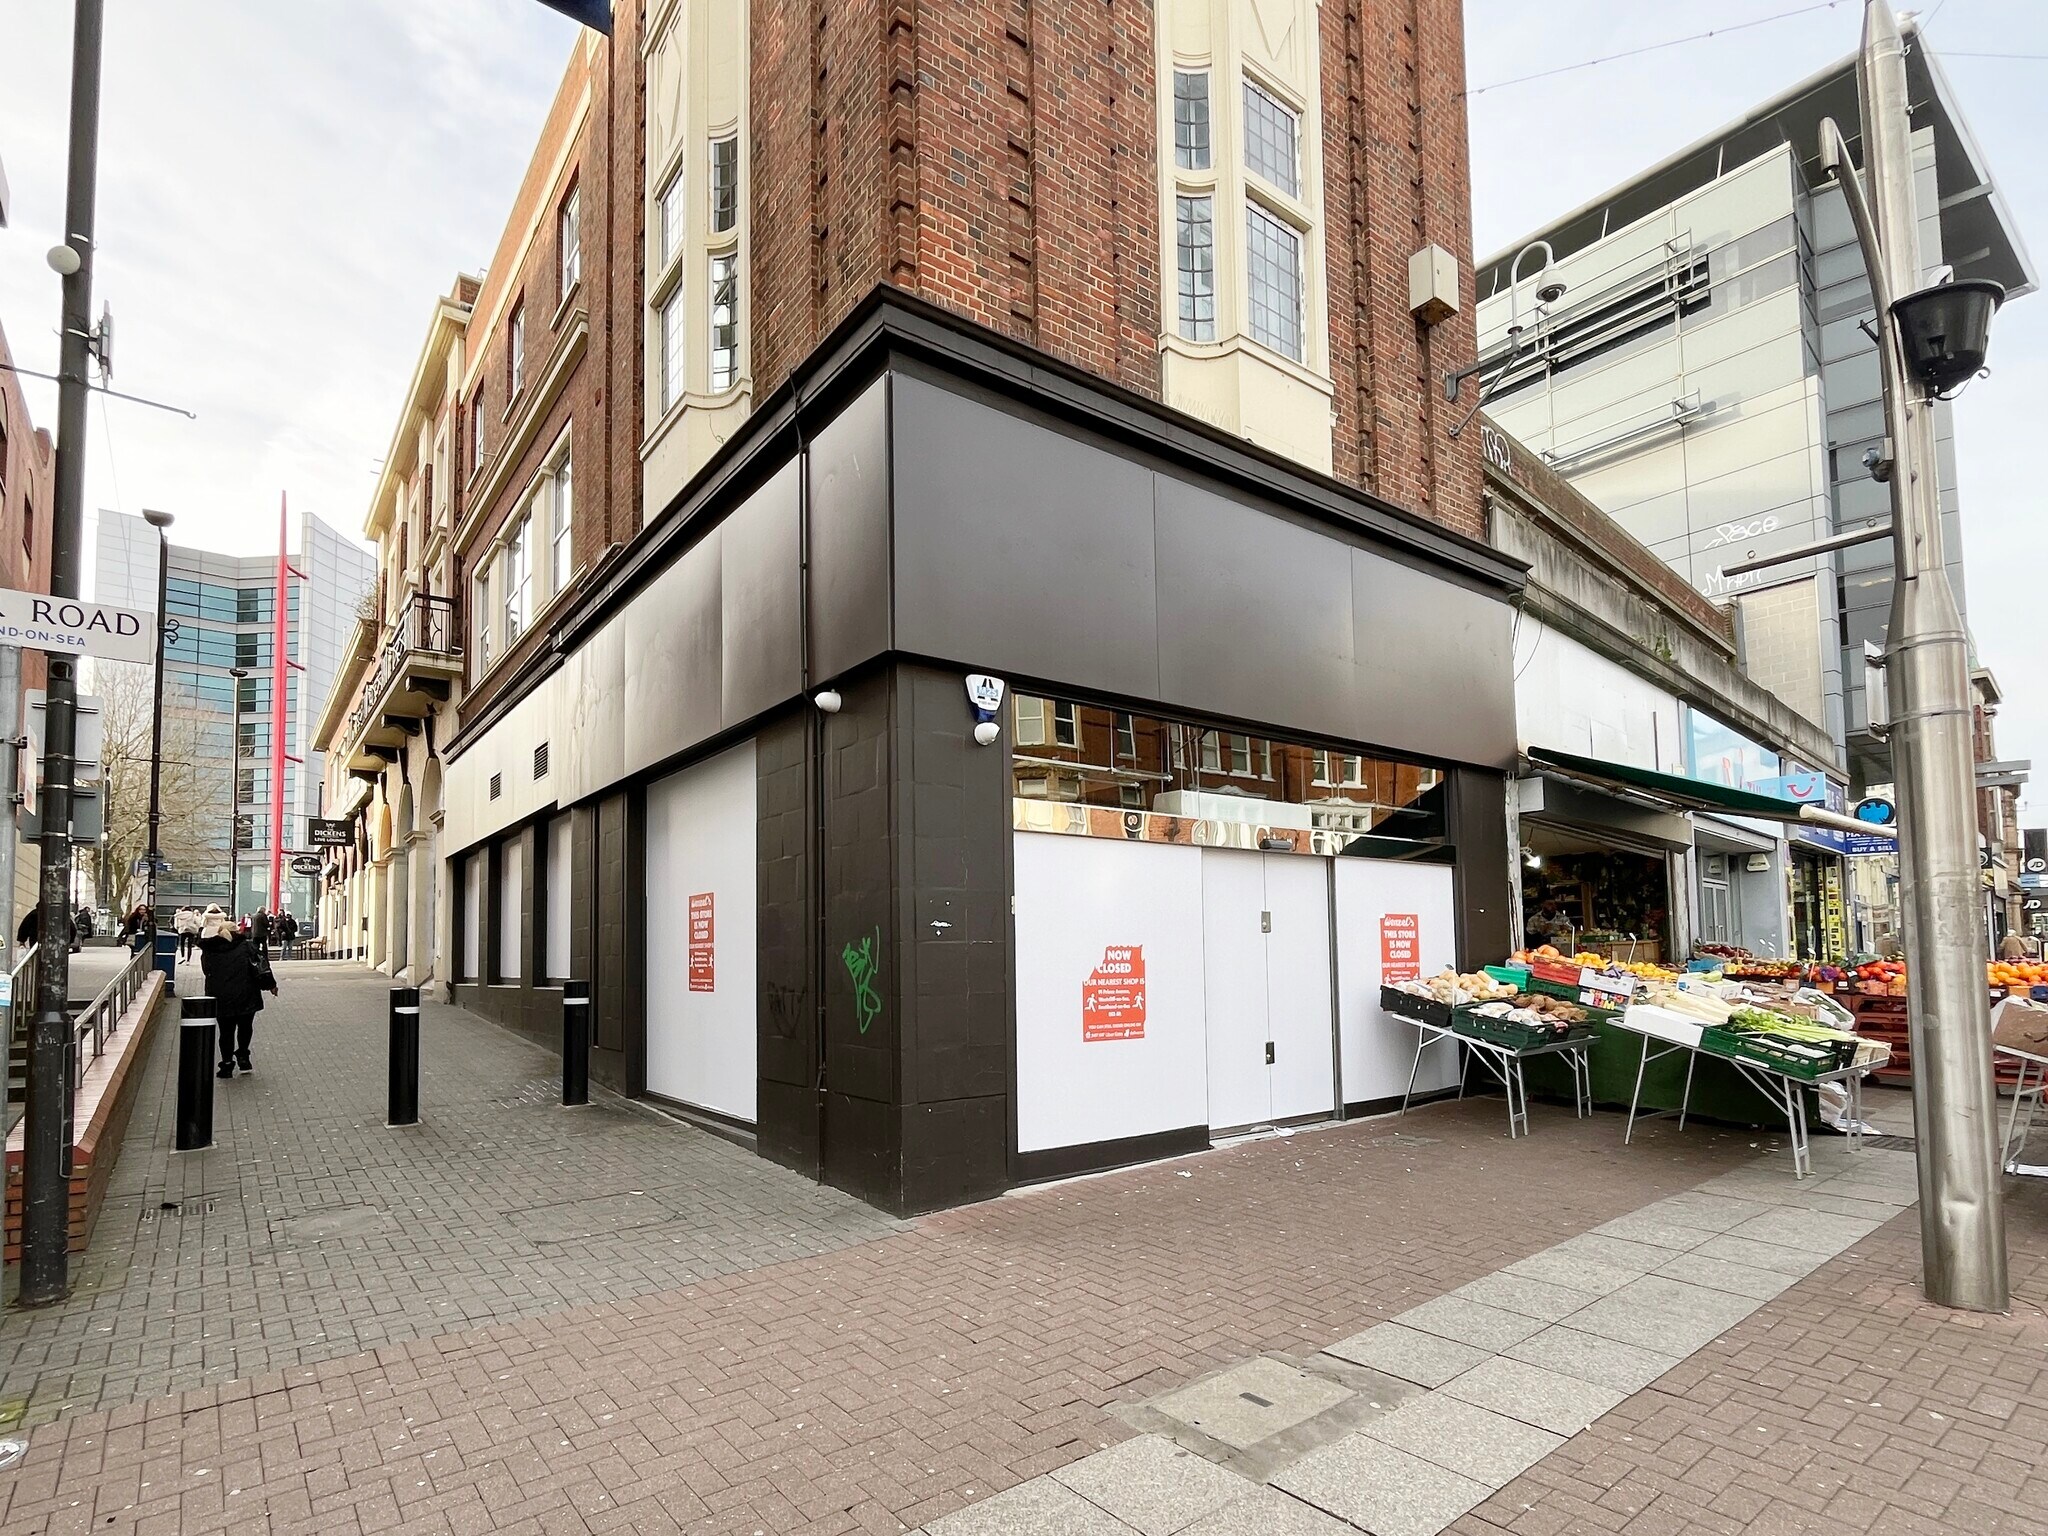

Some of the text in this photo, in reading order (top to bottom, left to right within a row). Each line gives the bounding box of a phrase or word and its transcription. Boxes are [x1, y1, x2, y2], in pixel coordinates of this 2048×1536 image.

[31, 599, 140, 636] ROAD
[2023, 899, 2041, 909] JD
[1384, 930, 1416, 938] THIS STORE
[1389, 940, 1411, 948] IS NOW
[1107, 950, 1132, 960] NOW
[1390, 950, 1412, 958] CLOSED
[1098, 963, 1132, 973] CLOSED
